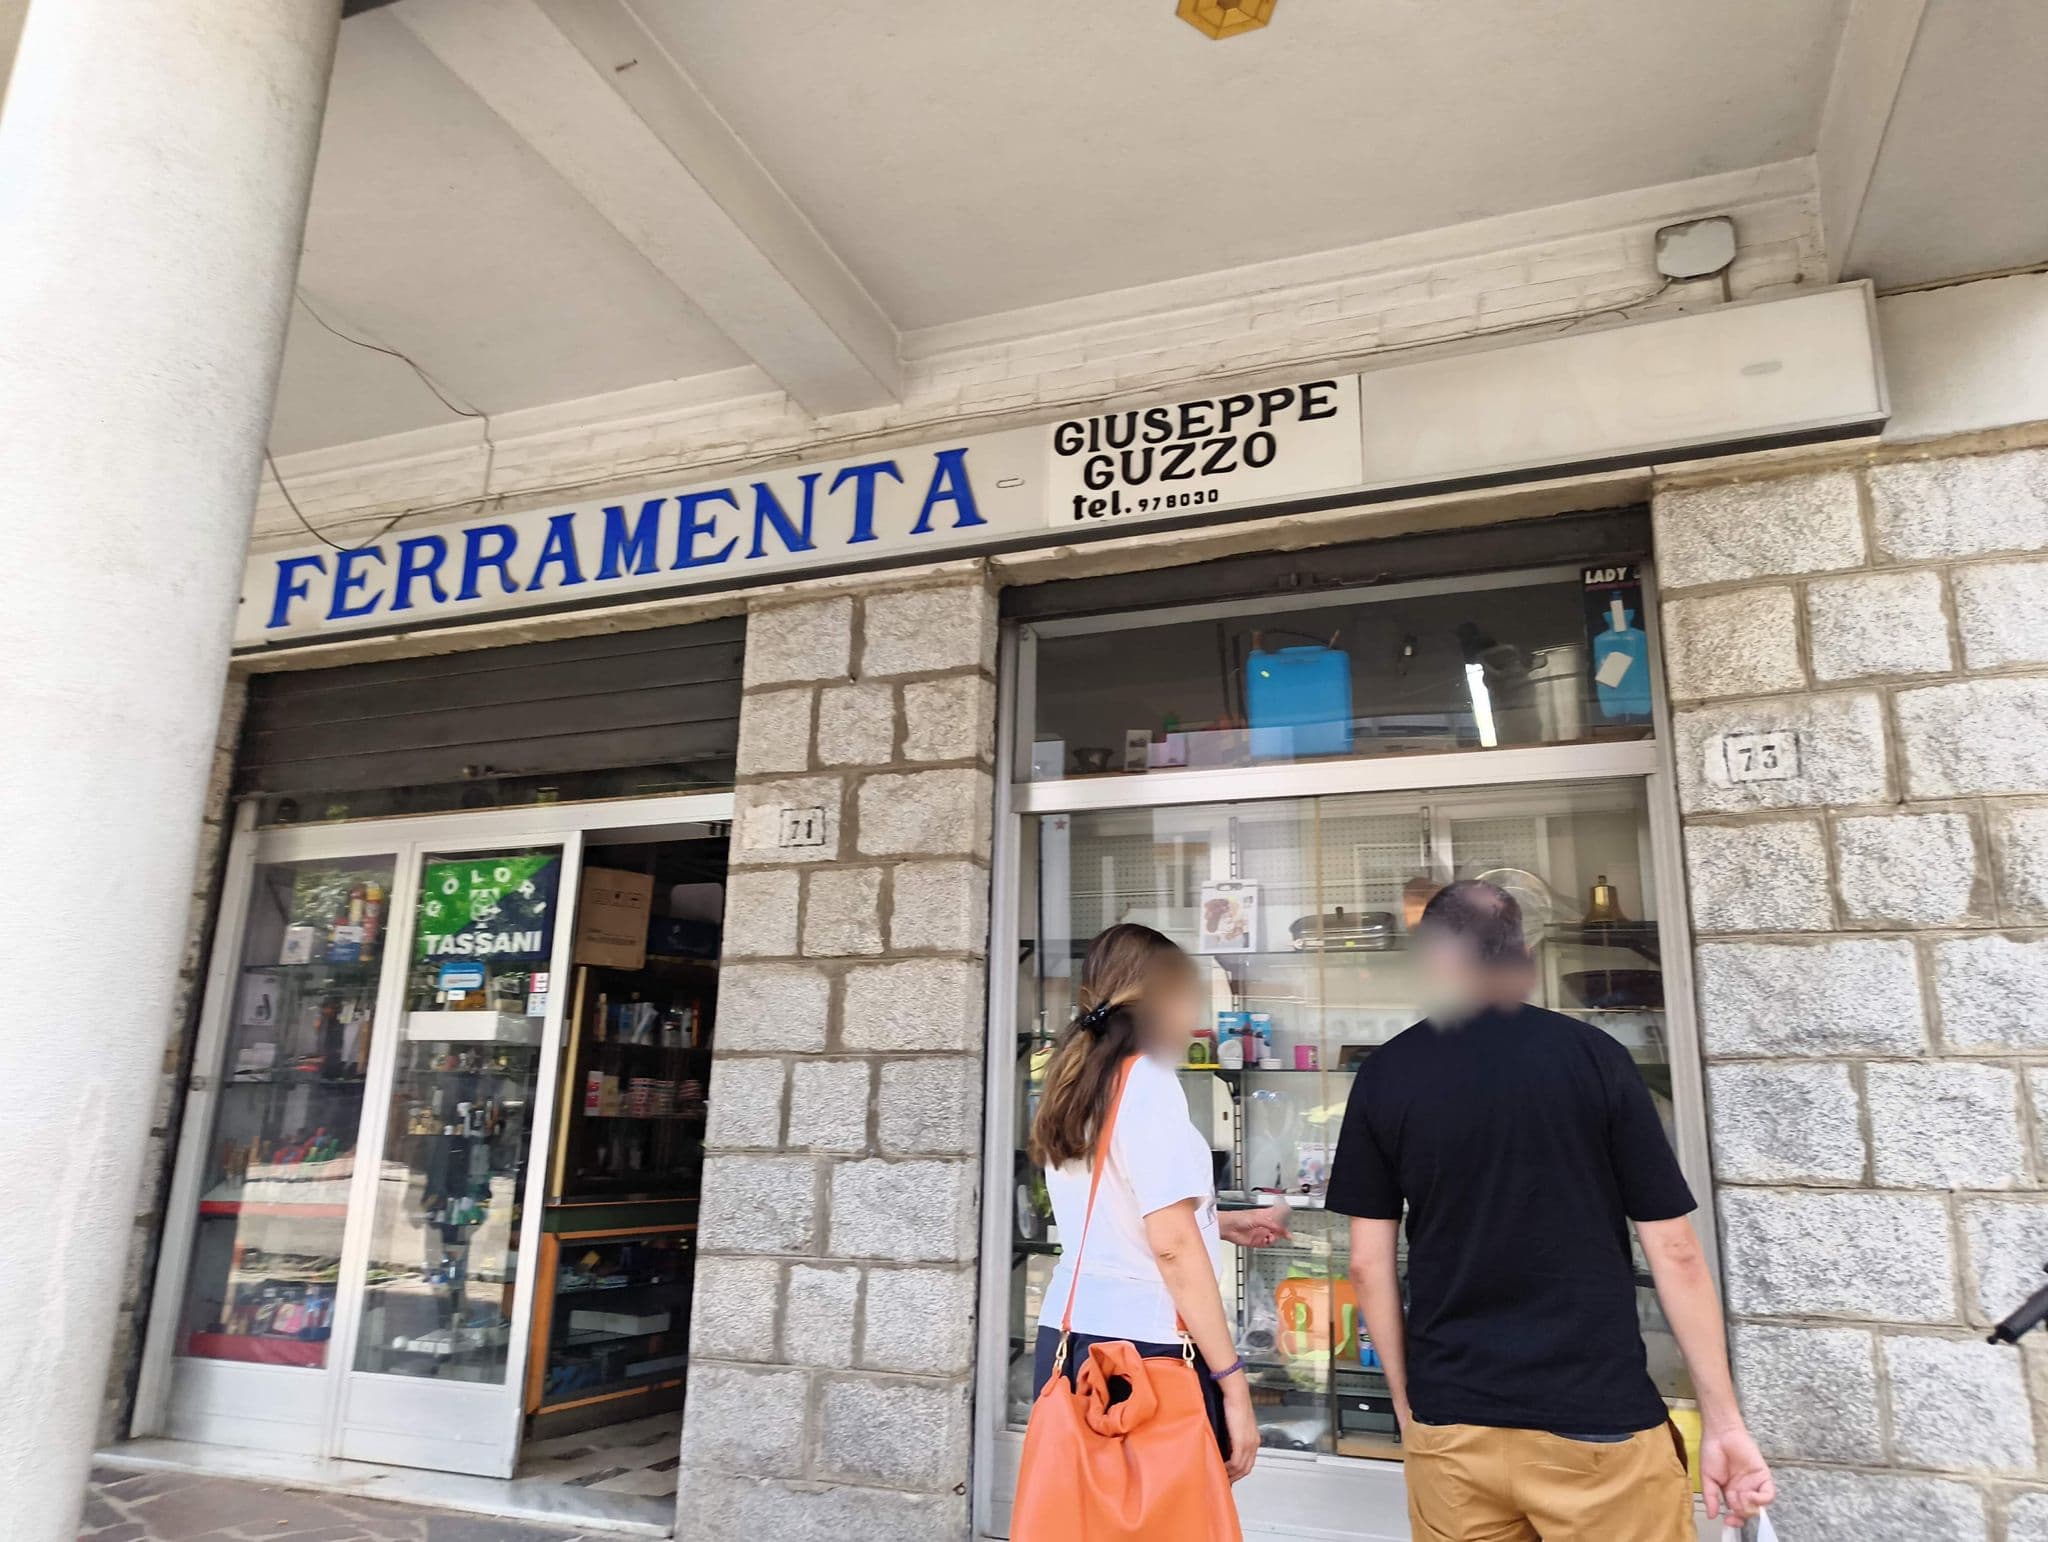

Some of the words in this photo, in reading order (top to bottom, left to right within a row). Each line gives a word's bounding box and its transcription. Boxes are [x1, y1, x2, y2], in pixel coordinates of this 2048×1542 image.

[1054, 380, 1338, 457] GIUSEPPE
[1083, 431, 1277, 491] GUZZO
[1138, 488, 1220, 512] 978030
[265, 447, 988, 630] FERRAMENTA
[1584, 567, 1628, 584] LADY
[1739, 745, 1779, 773] 73
[791, 819, 813, 839] 71
[424, 931, 543, 955] TASSANI
